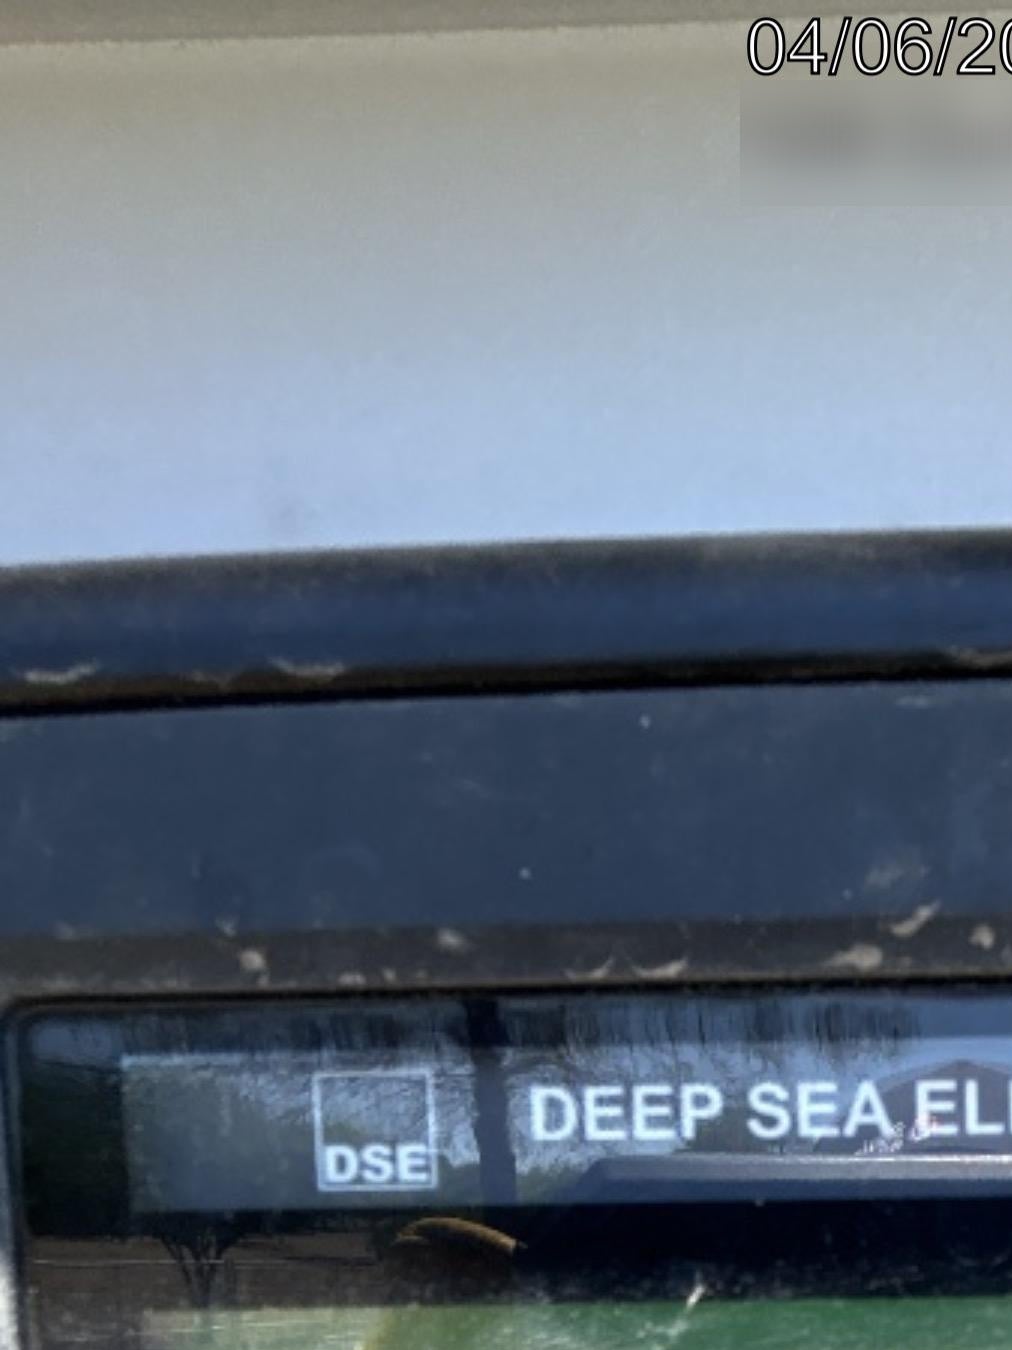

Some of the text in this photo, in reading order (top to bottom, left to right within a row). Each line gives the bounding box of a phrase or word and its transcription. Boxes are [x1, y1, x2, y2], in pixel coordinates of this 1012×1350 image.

[530, 1084, 724, 1141] DEEP
[747, 1081, 894, 1137] SEA
[325, 1145, 431, 1184] DSE
